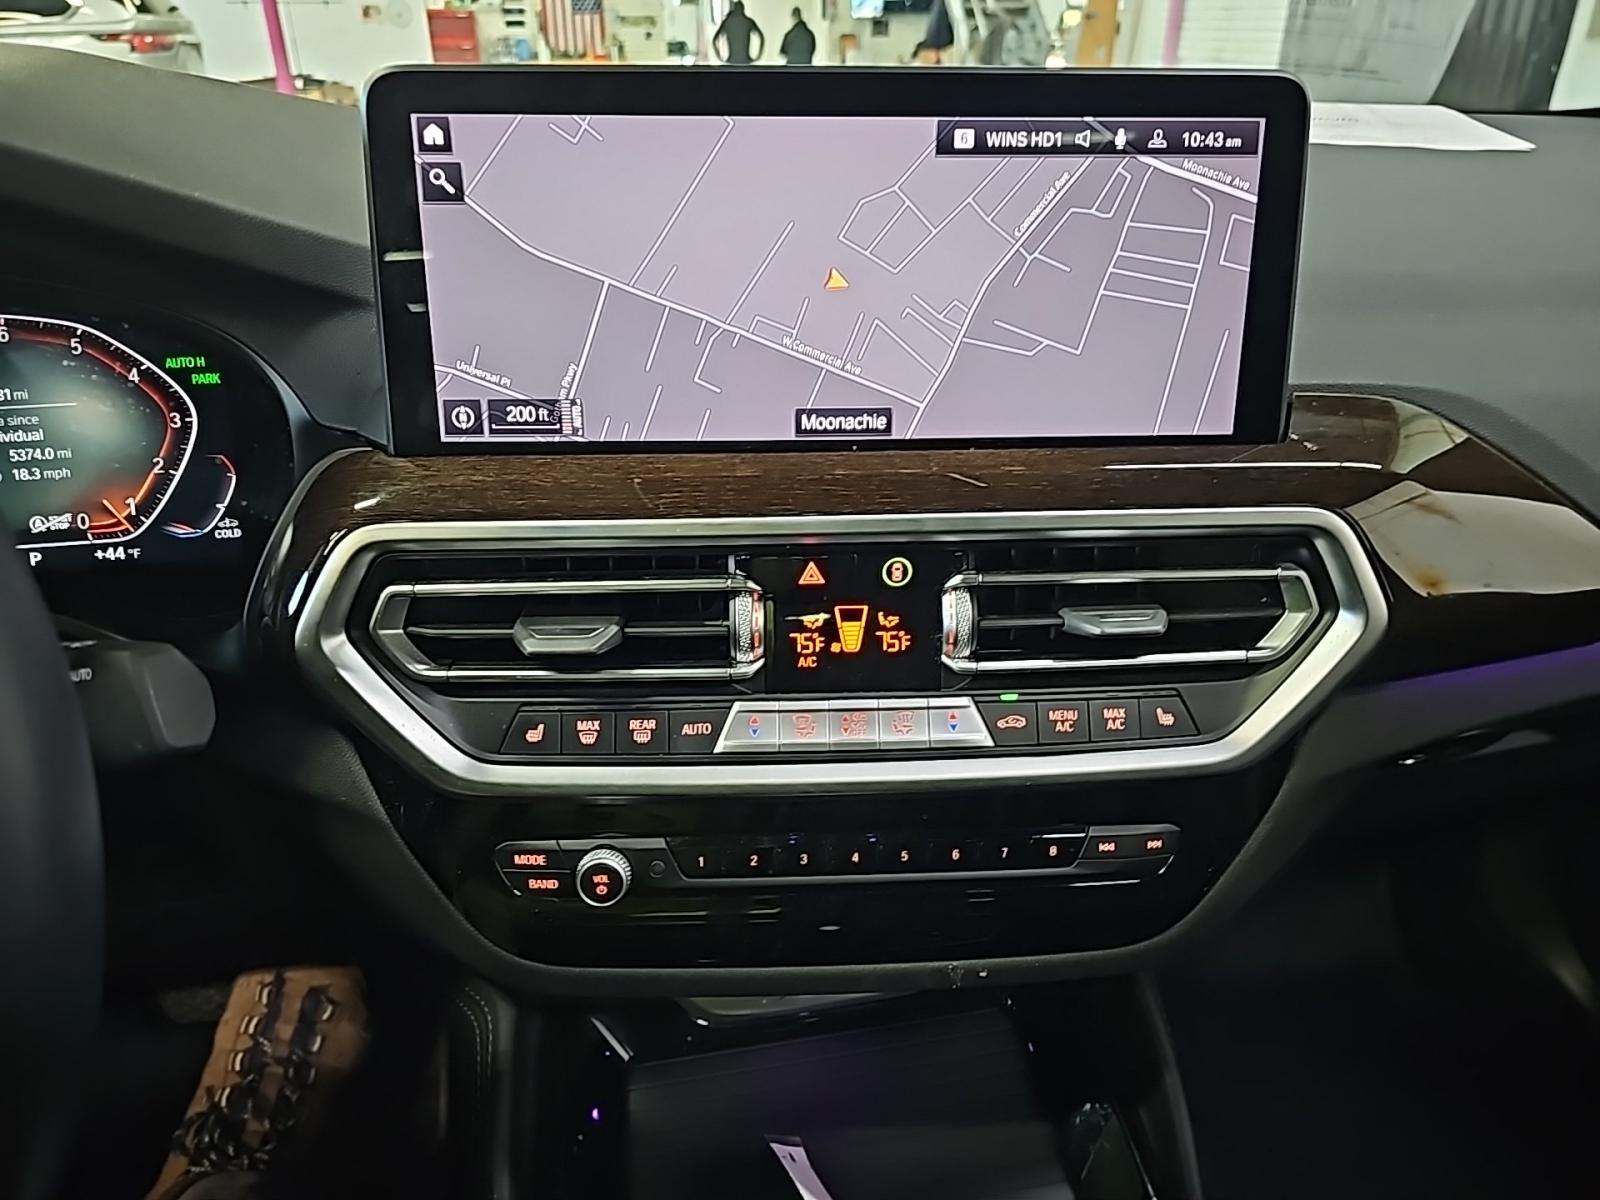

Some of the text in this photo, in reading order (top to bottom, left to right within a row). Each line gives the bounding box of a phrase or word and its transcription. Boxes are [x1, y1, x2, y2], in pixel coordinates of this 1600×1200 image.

[986, 131, 1063, 148] WINS HD1
[1182, 131, 1243, 148] 10:43 am
[1182, 158, 1233, 184] Moonachie
[70, 338, 82, 355] 5
[165, 357, 205, 369] AUTO H
[128, 366, 140, 384] 4
[191, 373, 221, 385] PARK
[13, 389, 29, 400] mi
[506, 405, 550, 422] 200 ft
[7, 415, 40, 426] since
[169, 413, 181, 429] 3
[801, 412, 888, 430] Moonachie
[9, 447, 72, 462] 5374.0 mi
[152, 457, 165, 474] 2
[12, 467, 71, 481] 18.3 mph
[125, 497, 137, 516] 1
[76, 513, 90, 530] 0
[215, 528, 242, 539] COLD
[29, 552, 42, 567] P
[94, 546, 126, 561] +44
[797, 656, 818, 668] A/C
[69, 667, 93, 682] UTO
[1048, 709, 1079, 721] MENU
[1103, 708, 1127, 719] MAX
[576, 720, 601, 731] MAX
[629, 719, 656, 730] REAR
[682, 722, 712, 736] AUTO
[1055, 720, 1075, 732] A/C
[1106, 718, 1126, 731] A/C
[852, 852, 860, 863] 4
[901, 851, 909, 862] 5
[951, 849, 960, 860] 6
[1001, 847, 1009, 859] 7
[1049, 846, 1058, 857] 8
[514, 854, 548, 866] MODE
[698, 856, 704, 868] 1
[750, 855, 758, 867] 2
[800, 853, 808, 866] 3
[528, 878, 560, 889] BAND
[592, 874, 610, 884] VOL
